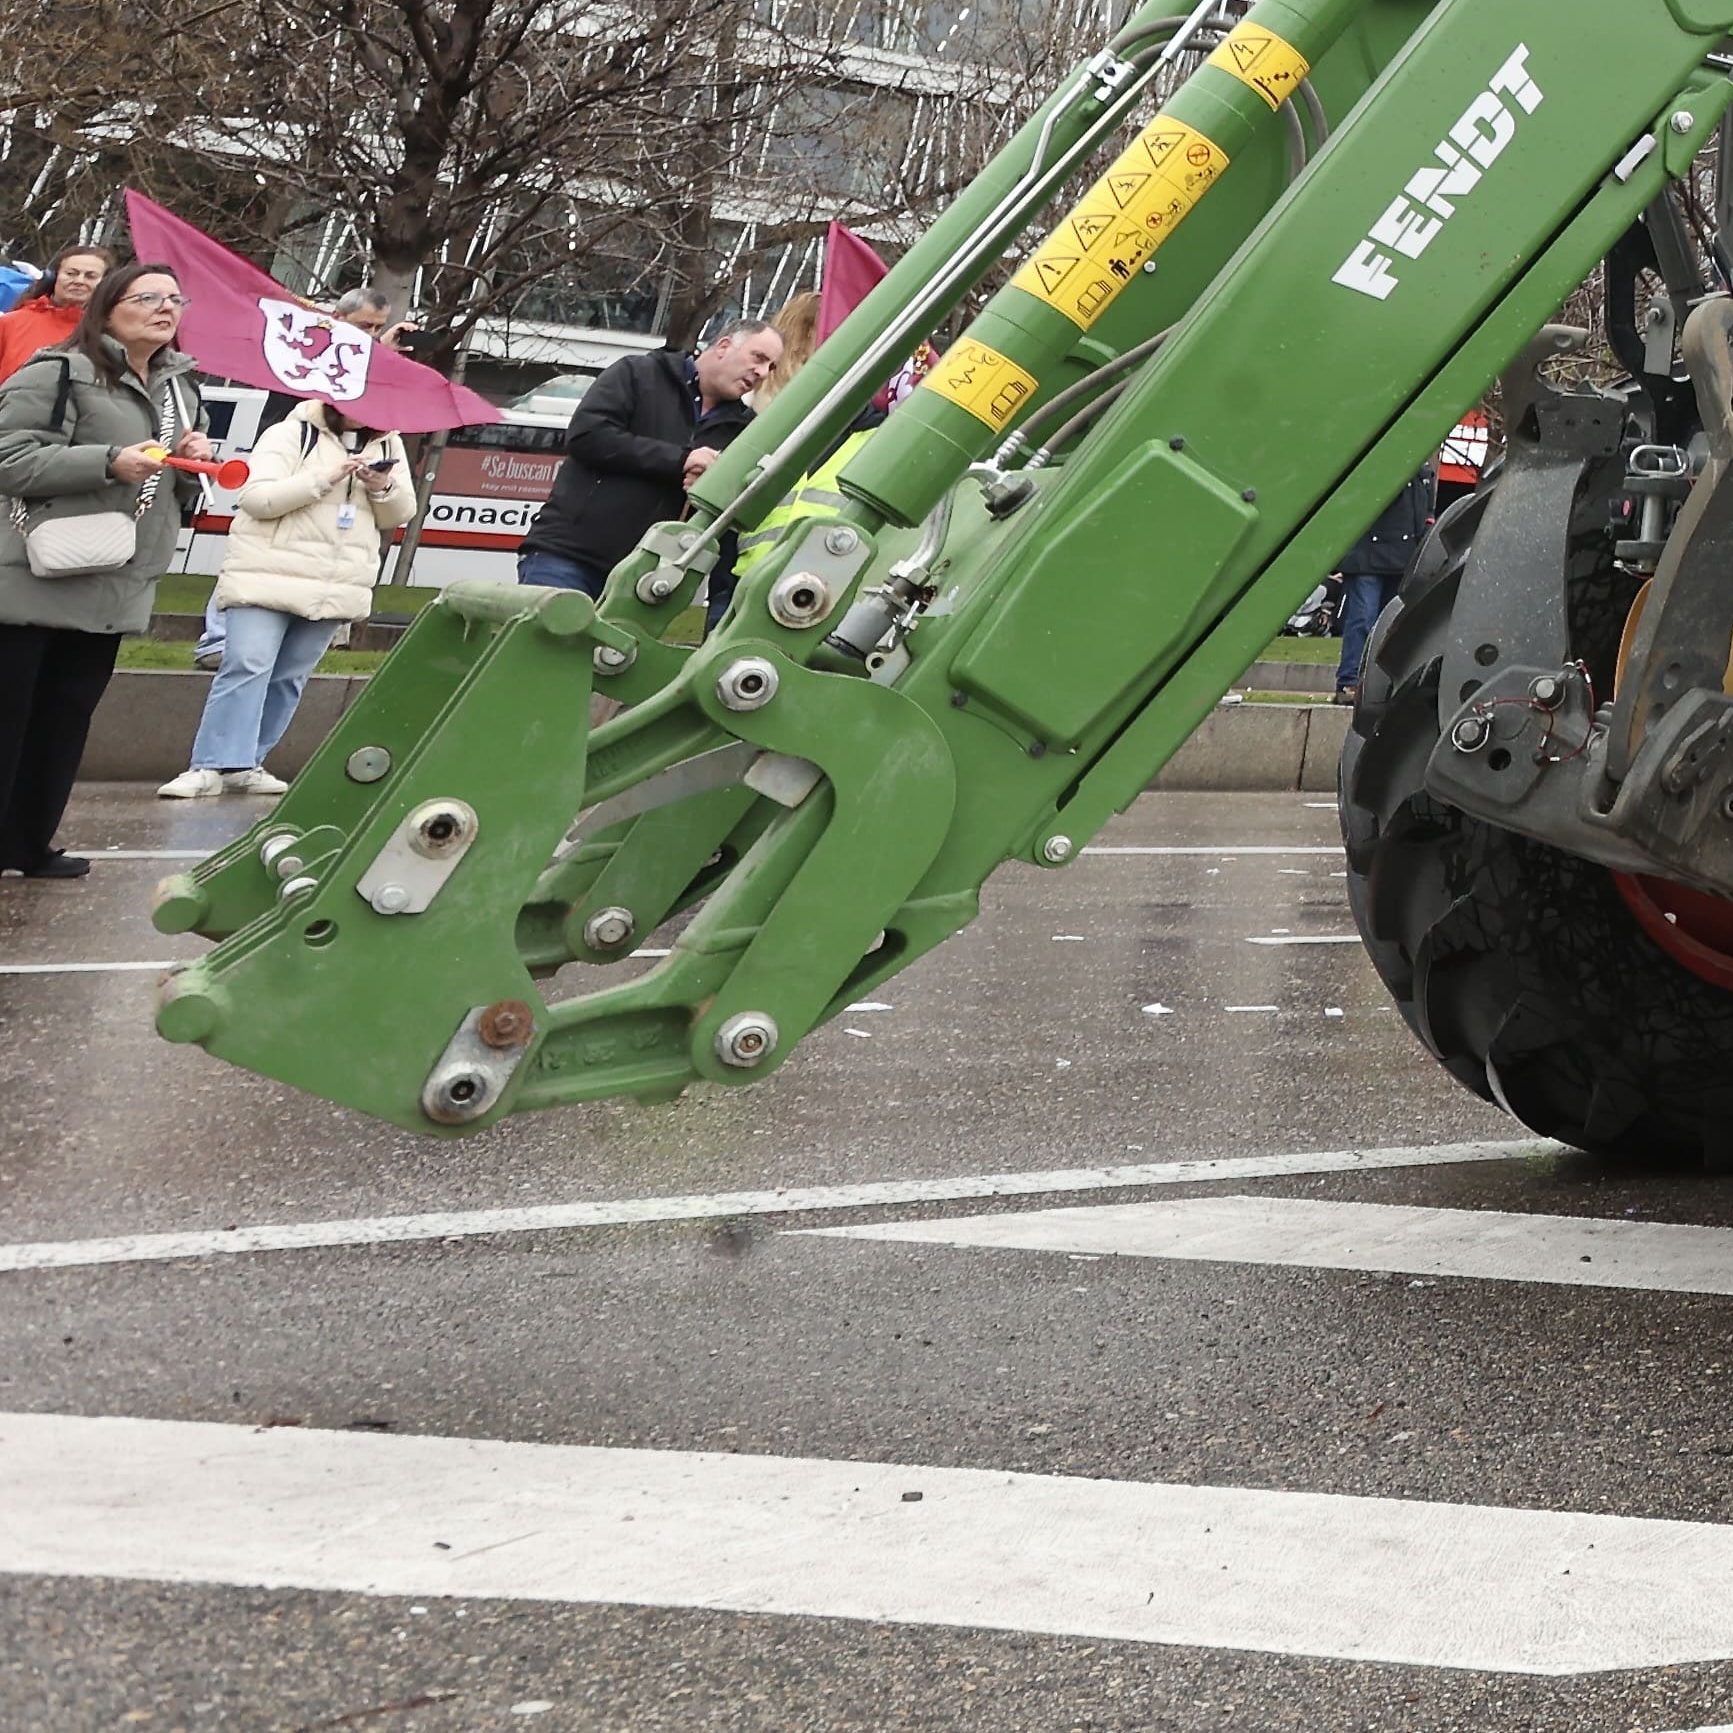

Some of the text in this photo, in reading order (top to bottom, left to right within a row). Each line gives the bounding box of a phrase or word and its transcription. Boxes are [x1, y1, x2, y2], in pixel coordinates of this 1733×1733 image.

[1331, 41, 1545, 301] FENDT
[481, 455, 506, 479] #Se
[506, 457, 552, 483] buscan
[424, 503, 542, 528] onaci
